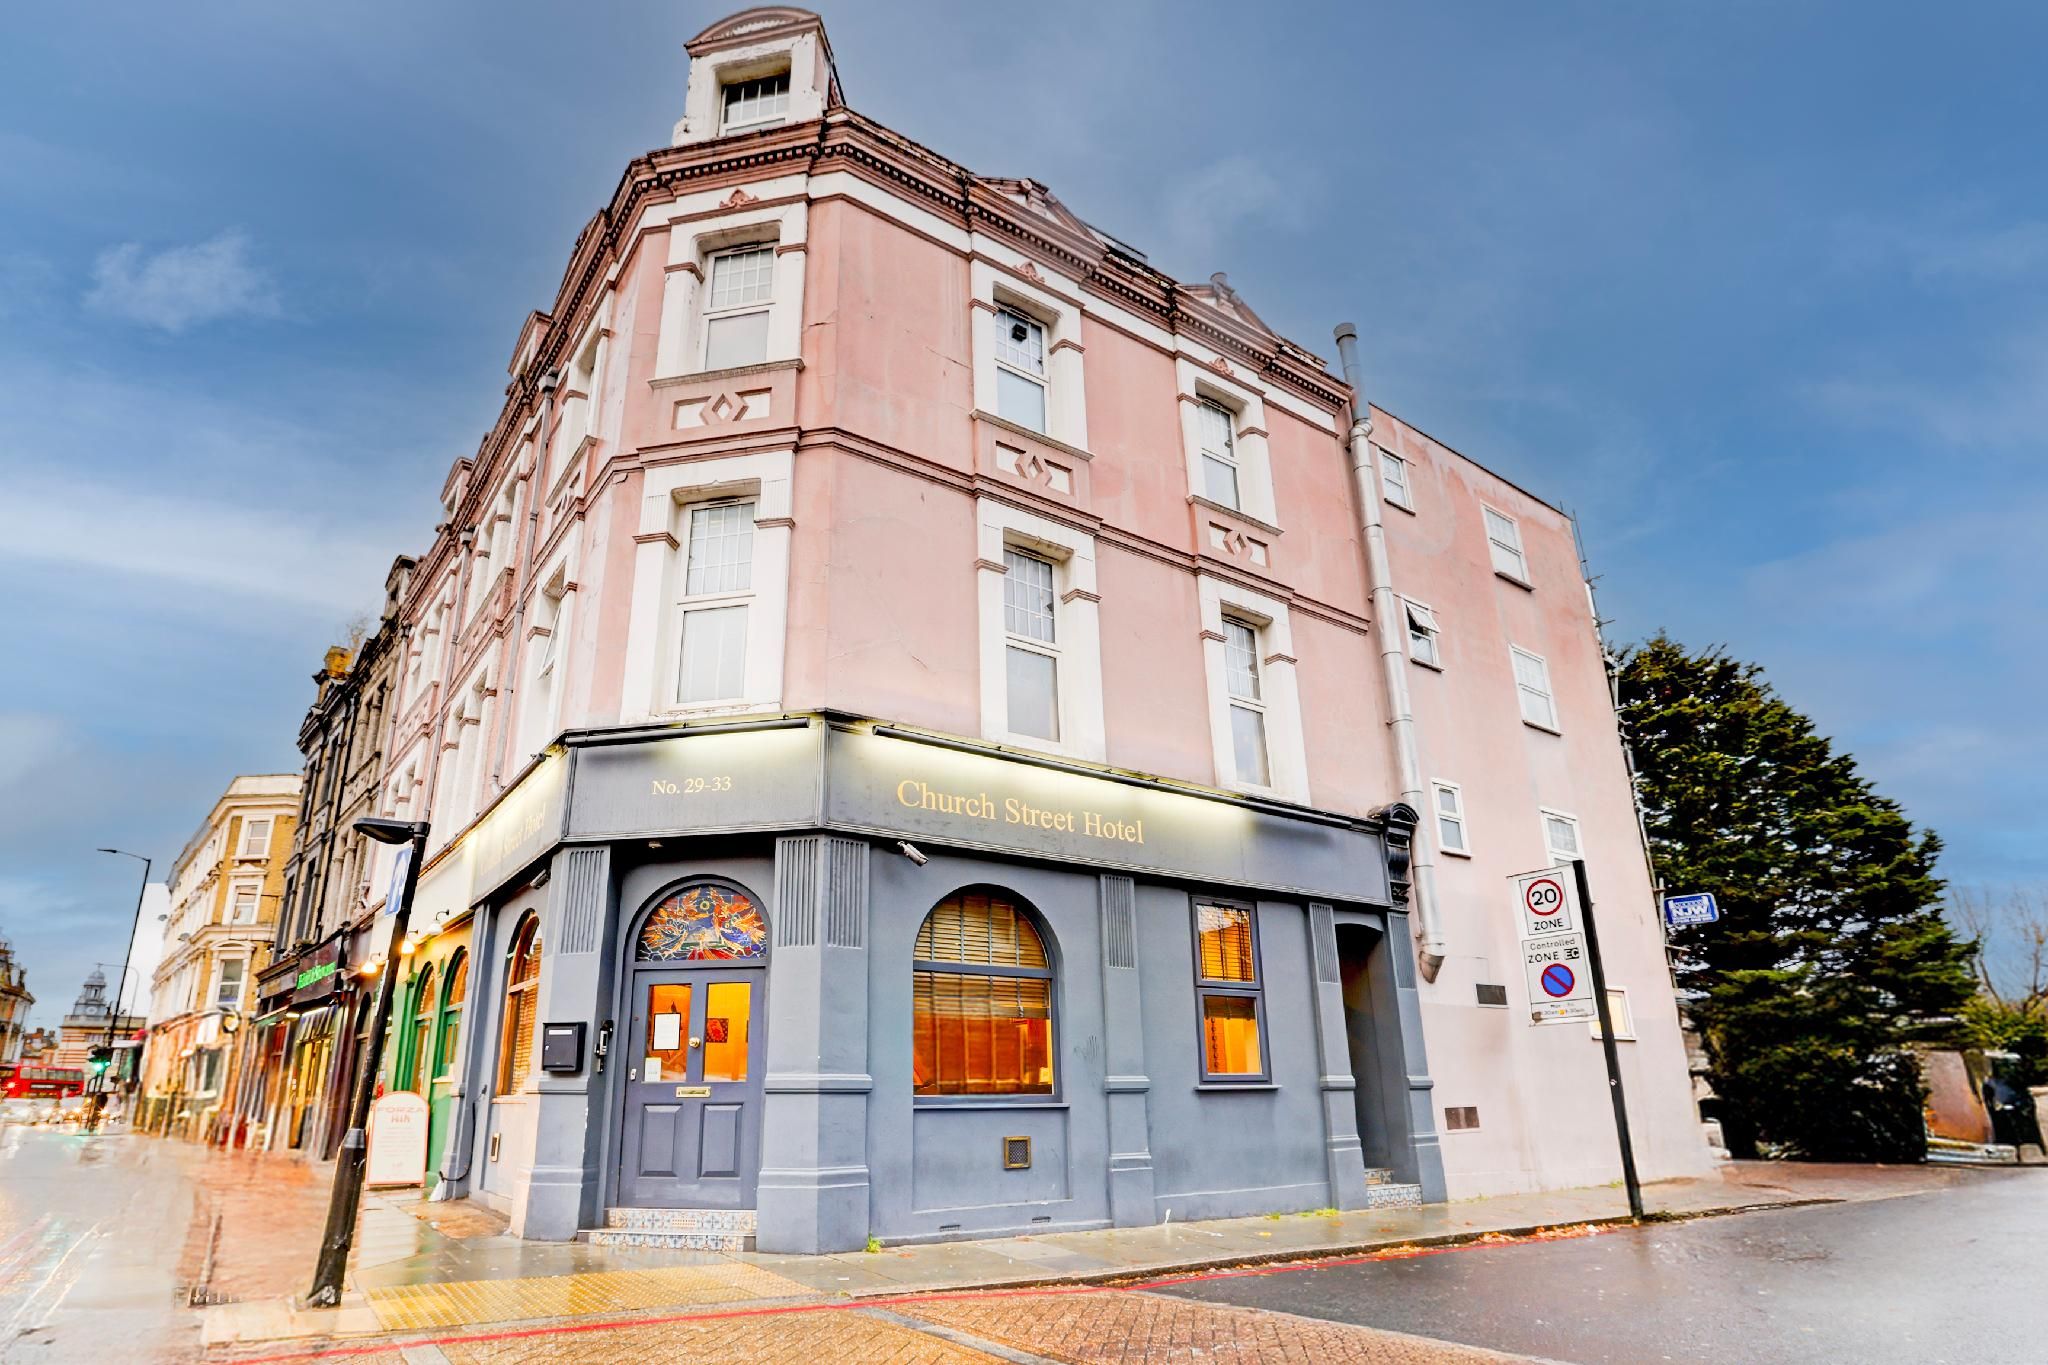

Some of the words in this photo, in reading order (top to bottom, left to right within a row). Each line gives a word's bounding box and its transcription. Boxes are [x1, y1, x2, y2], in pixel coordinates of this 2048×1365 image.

[652, 779, 681, 795] No.
[684, 776, 732, 793] 29-33
[896, 780, 997, 820] Church
[1005, 798, 1075, 832] Street
[1083, 811, 1145, 844] Hotel
[1532, 888, 1557, 905] 20
[1534, 918, 1564, 930] ZONE
[1530, 938, 1576, 950] Controlled
[1528, 951, 1560, 963] ZONE
[1564, 947, 1580, 960] EC
